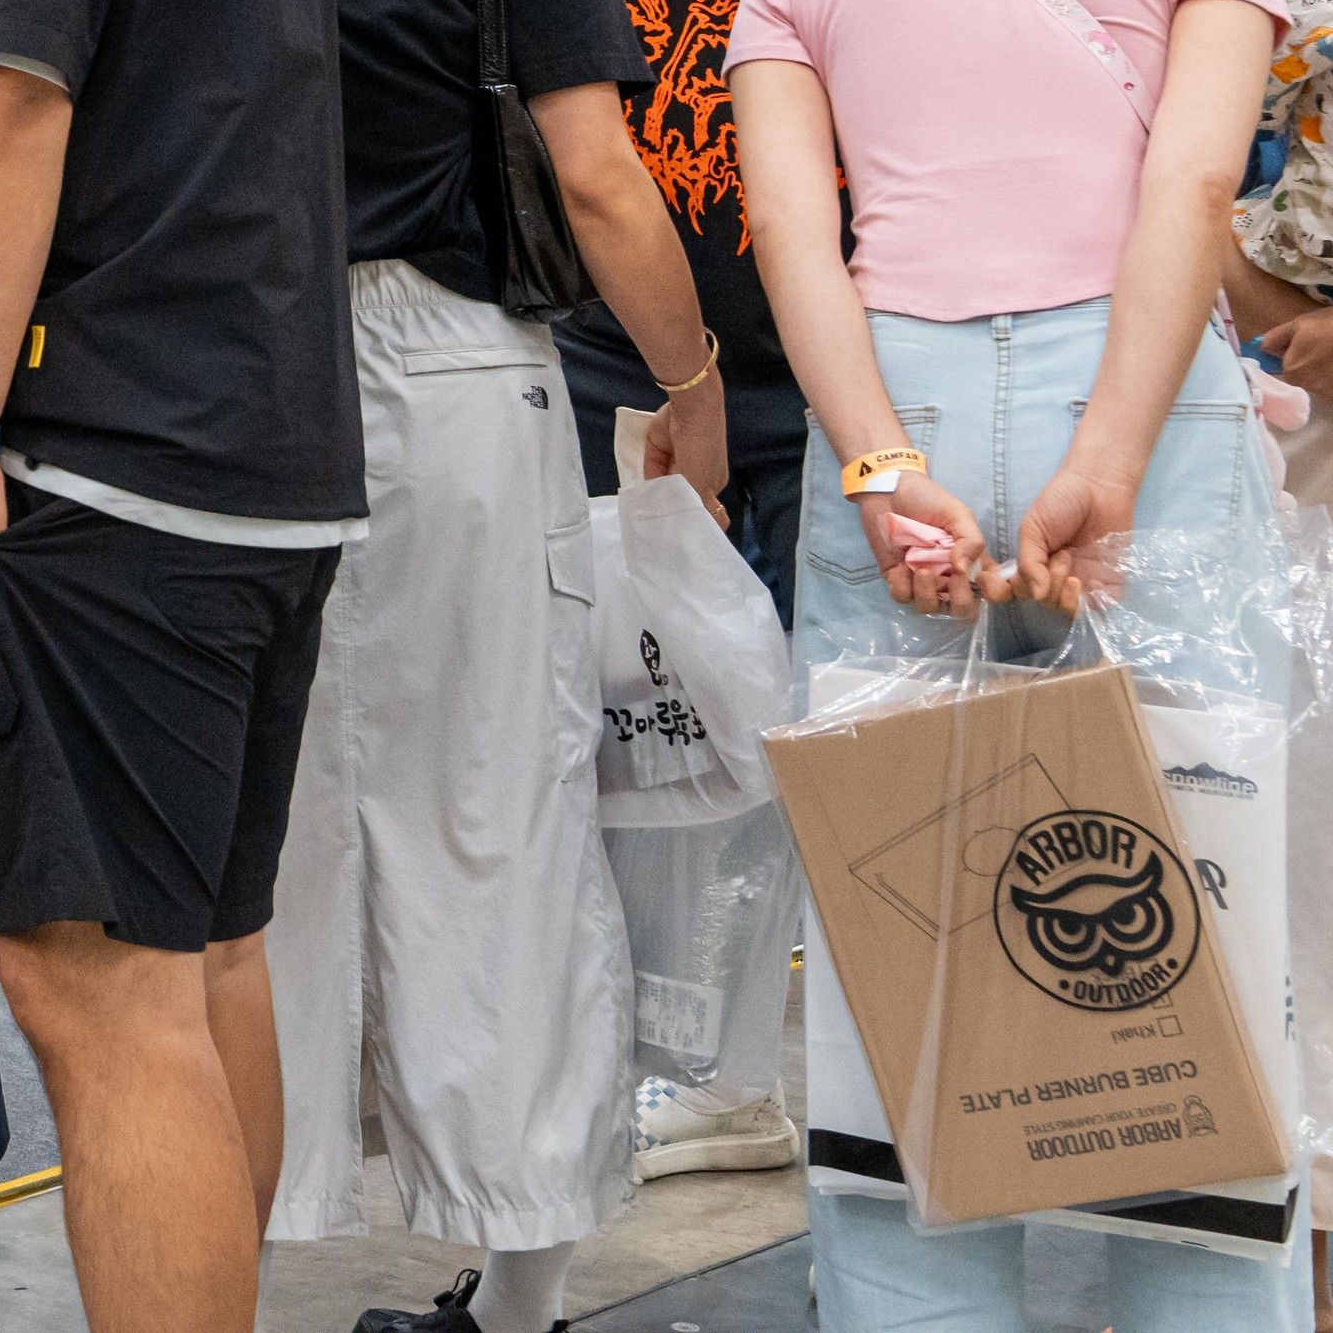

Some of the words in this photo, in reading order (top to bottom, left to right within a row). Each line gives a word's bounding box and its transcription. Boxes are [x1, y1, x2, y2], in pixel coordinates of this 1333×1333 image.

[1015, 820, 1136, 886] ARBOR
[1074, 963, 1171, 1003] OUTDOOR
[1111, 1023, 1156, 1043] Khaki
[1036, 1071, 1129, 1101] BURNER
[1135, 1060, 1198, 1086] CUBE
[960, 1086, 1031, 1113] PLATE
[1027, 1129, 1115, 1161] OUTDOOR
[1117, 1118, 1182, 1146] ARBOR
